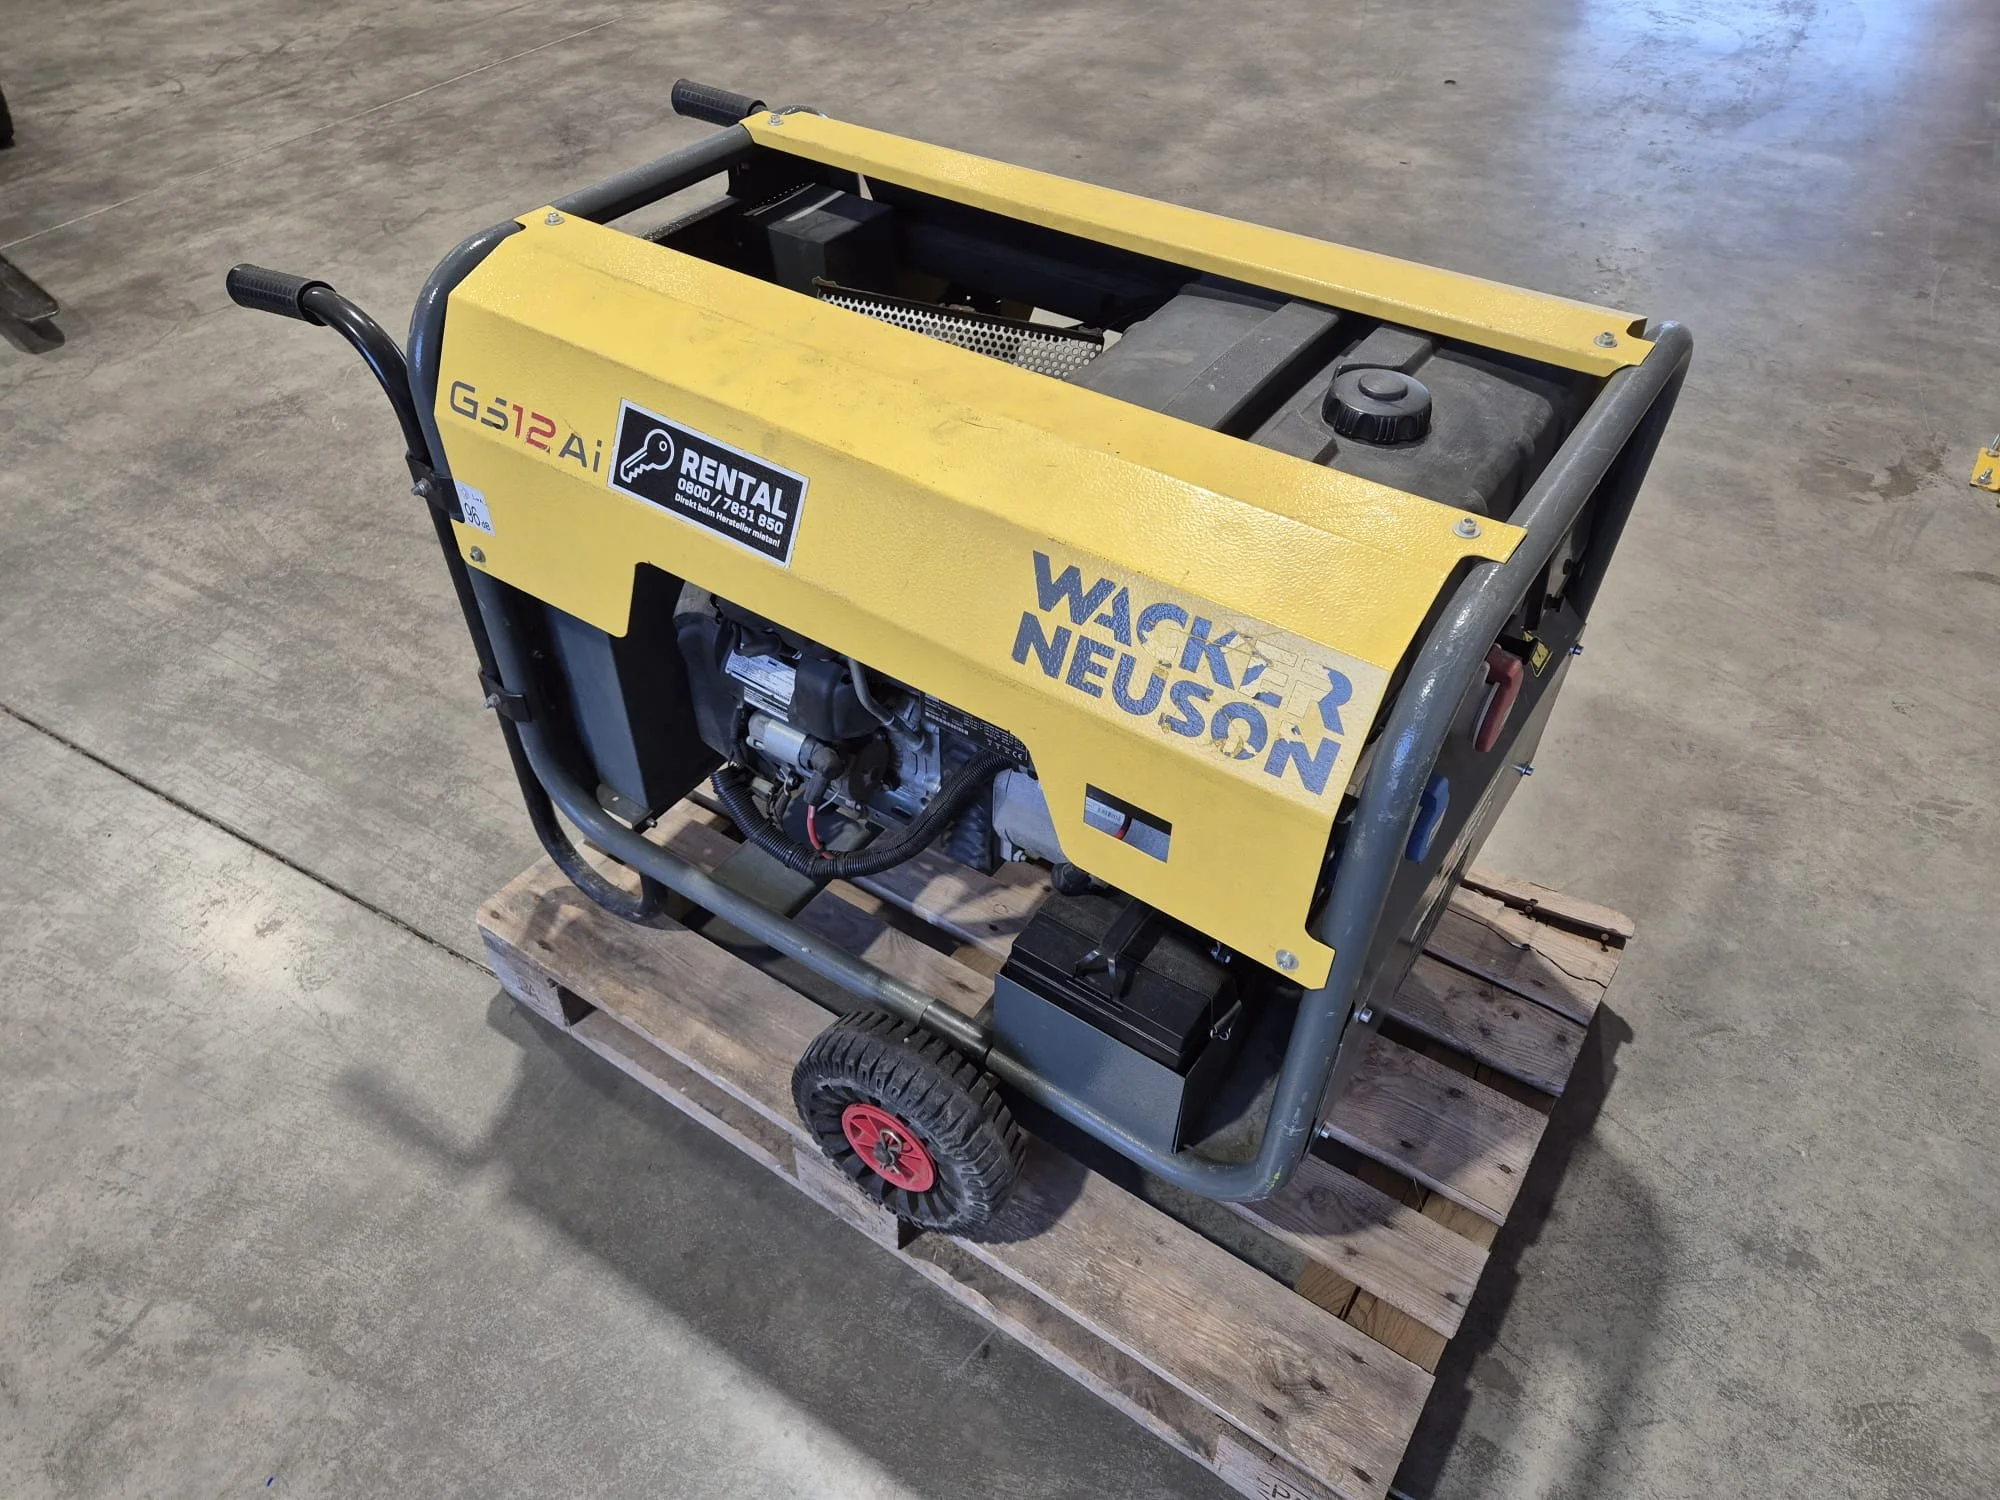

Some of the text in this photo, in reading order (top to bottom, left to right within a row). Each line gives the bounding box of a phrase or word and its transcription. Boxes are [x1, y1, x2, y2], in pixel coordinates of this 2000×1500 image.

[677, 477, 784, 535] 0800 / 7831 850
[680, 447, 788, 520] RENTAL
[464, 502, 481, 526] 96
[674, 493, 780, 548] Direkt beim Hersteller mieten!
[1011, 611, 1342, 795] NEUSON
